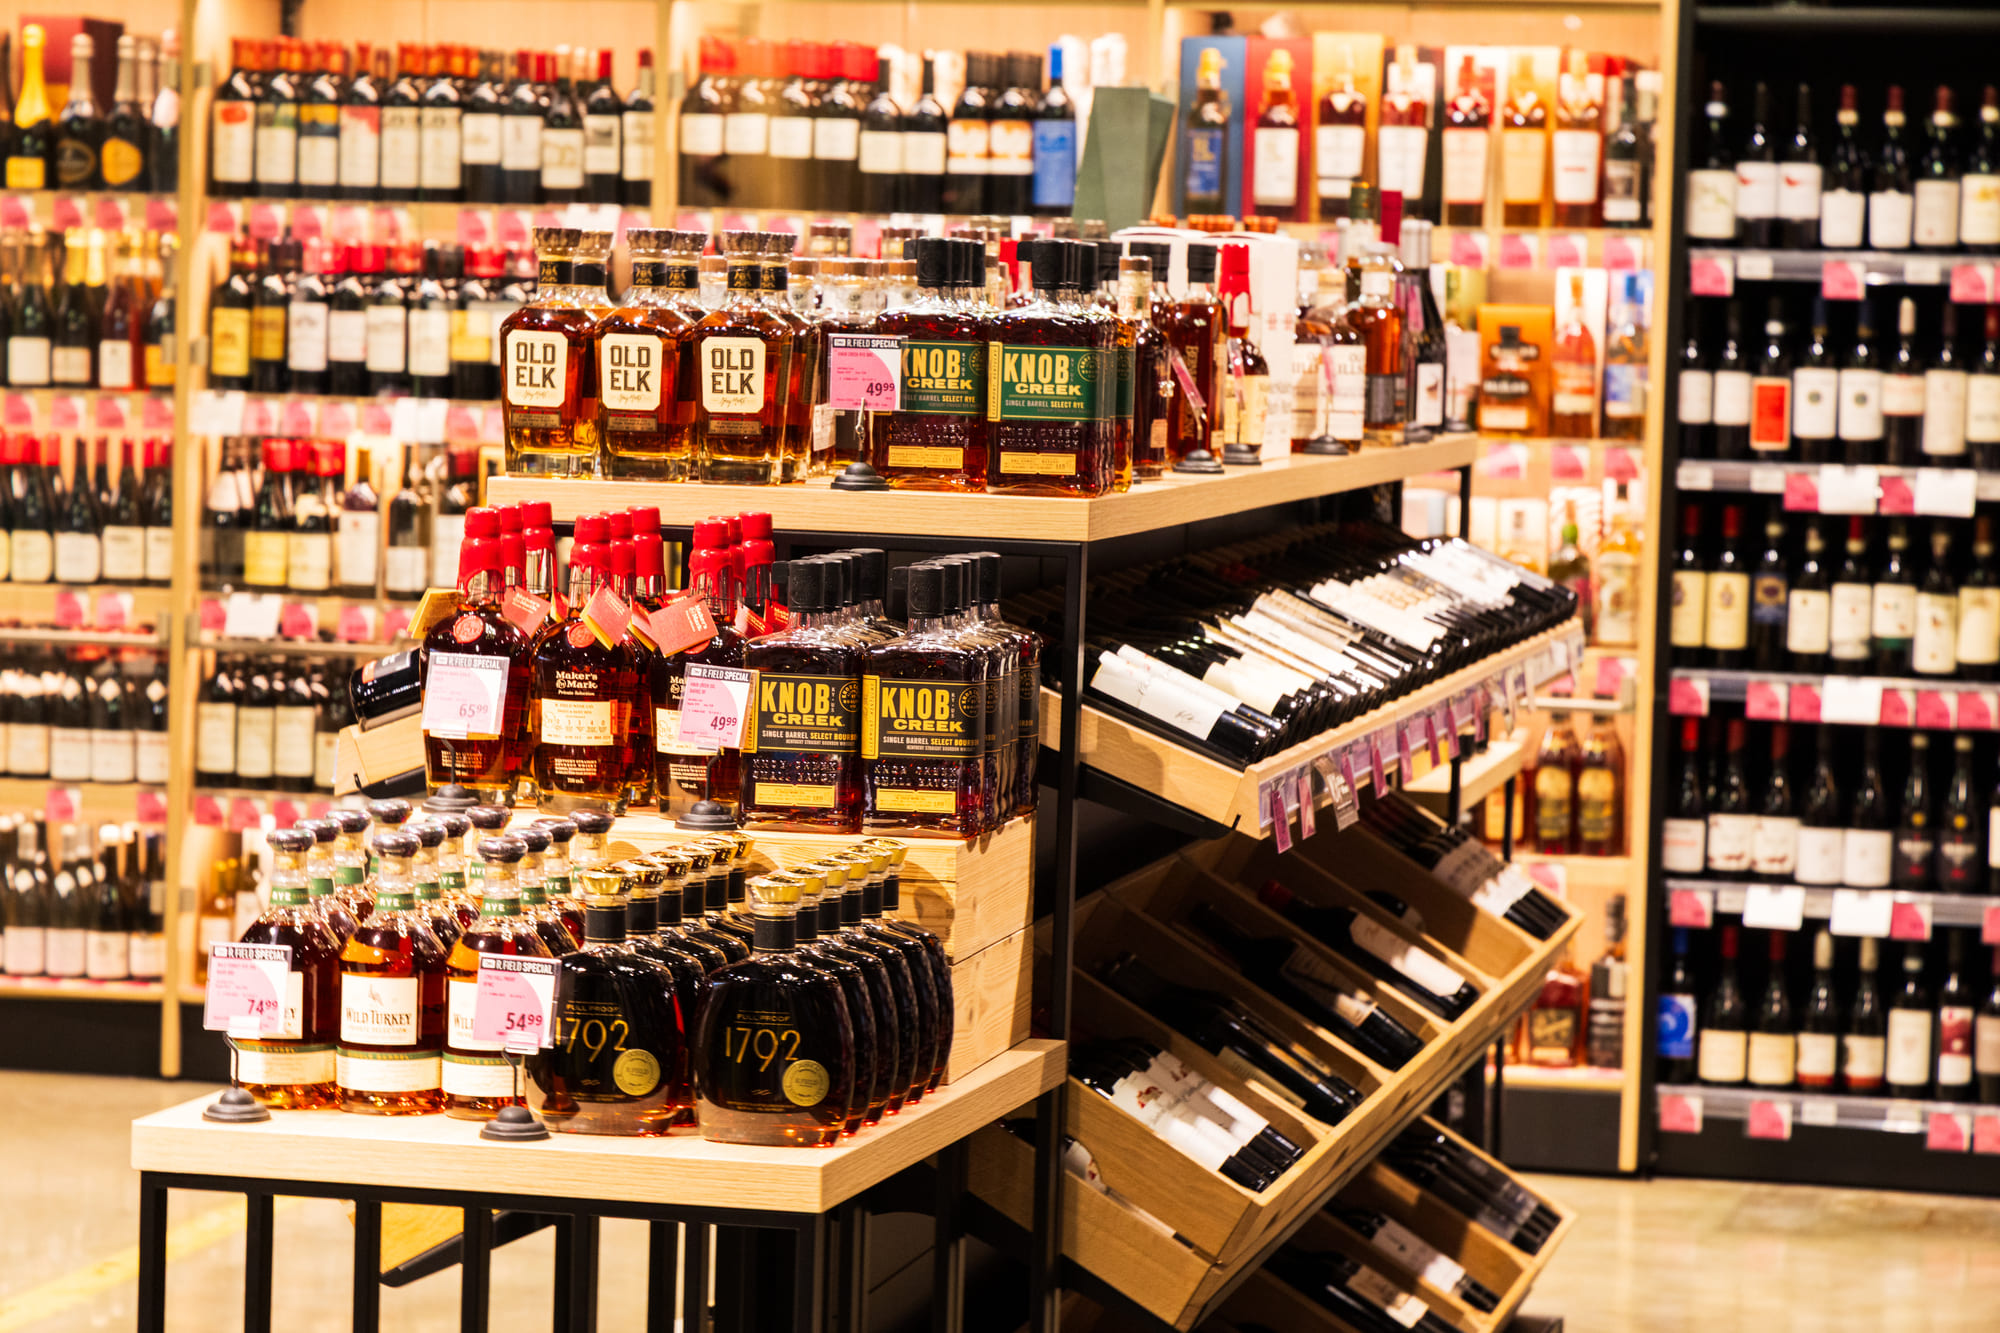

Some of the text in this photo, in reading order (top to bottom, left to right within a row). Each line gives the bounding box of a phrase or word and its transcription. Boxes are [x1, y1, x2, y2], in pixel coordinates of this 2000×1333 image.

[871, 339, 899, 348] SPECIAL
[516, 341, 556, 365] OLD
[610, 345, 650, 368] OLD
[711, 348, 754, 371] OLD
[1004, 353, 1069, 384] KNOB
[516, 365, 556, 389] ELK
[610, 369, 651, 392] ELK
[711, 372, 755, 394] ELK
[907, 378, 973, 390] CREEK
[1015, 383, 1082, 396] CREEK
[473, 658, 501, 669] SPECIAL
[724, 672, 749, 682] SPECIAL
[761, 681, 830, 715] KNOB
[881, 687, 950, 720] KNOB
[772, 713, 843, 727] CREEK
[893, 719, 963, 732] CREEK
[762, 730, 784, 738] SINGLE
[785, 731, 808, 739] BARREL
[810, 732, 832, 740] SELECT
[883, 736, 904, 744] SINGLE
[906, 737, 929, 745] BARREL
[930, 738, 952, 746] SELECT
[379, 897, 400, 907] RYE
[485, 902, 505, 912] RYE
[255, 949, 285, 961] SPECIAL
[523, 962, 553, 974] SPECIAL
[555, 1017, 629, 1063] 1792
[725, 1026, 800, 1072] 1792
